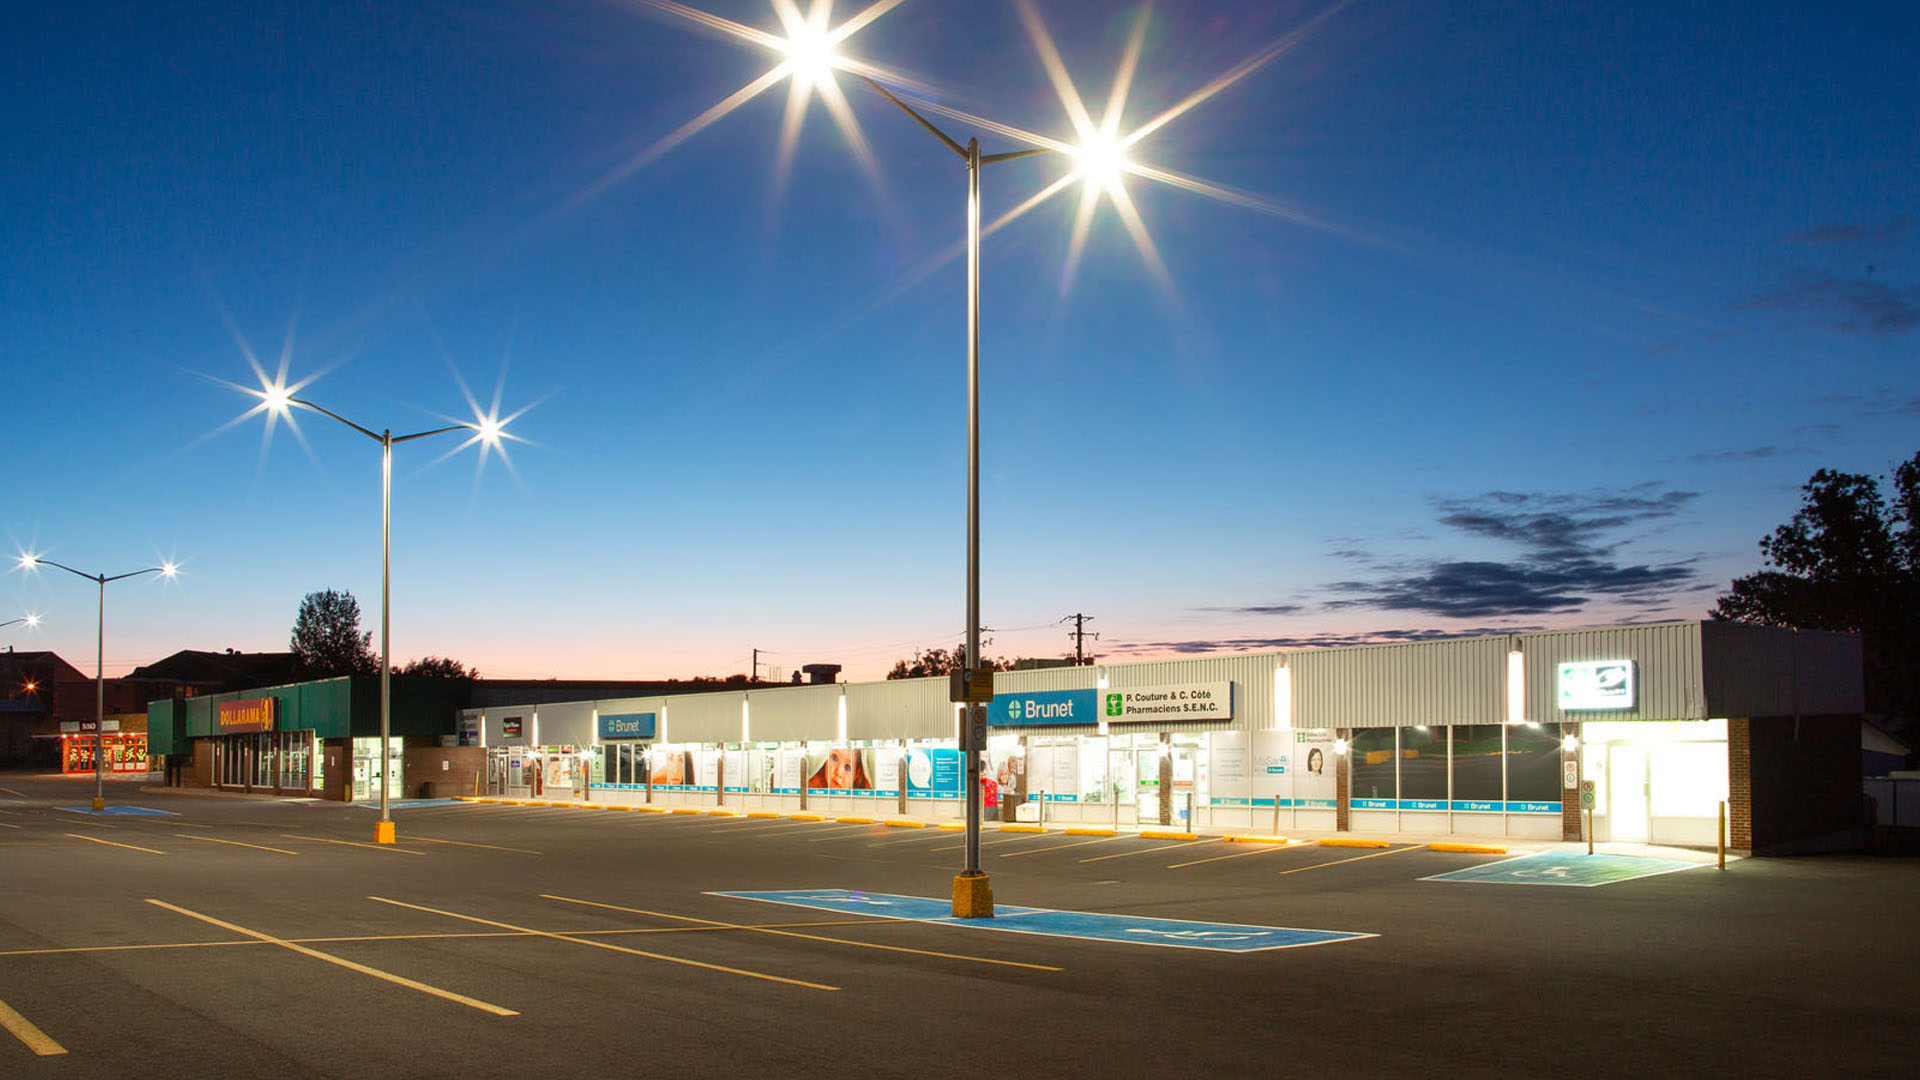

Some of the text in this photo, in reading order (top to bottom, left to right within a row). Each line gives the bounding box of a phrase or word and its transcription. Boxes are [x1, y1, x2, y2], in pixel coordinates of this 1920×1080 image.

[1126, 689, 1212, 702] P. Couture & C. Côté
[1025, 699, 1074, 719] Brunet
[1126, 702, 1218, 714] Pharmaciens S.E.N.C.
[220, 707, 260, 726] DOLLARAMA
[616, 719, 640, 733] Brunet
[1470, 802, 1491, 810] Brunet
